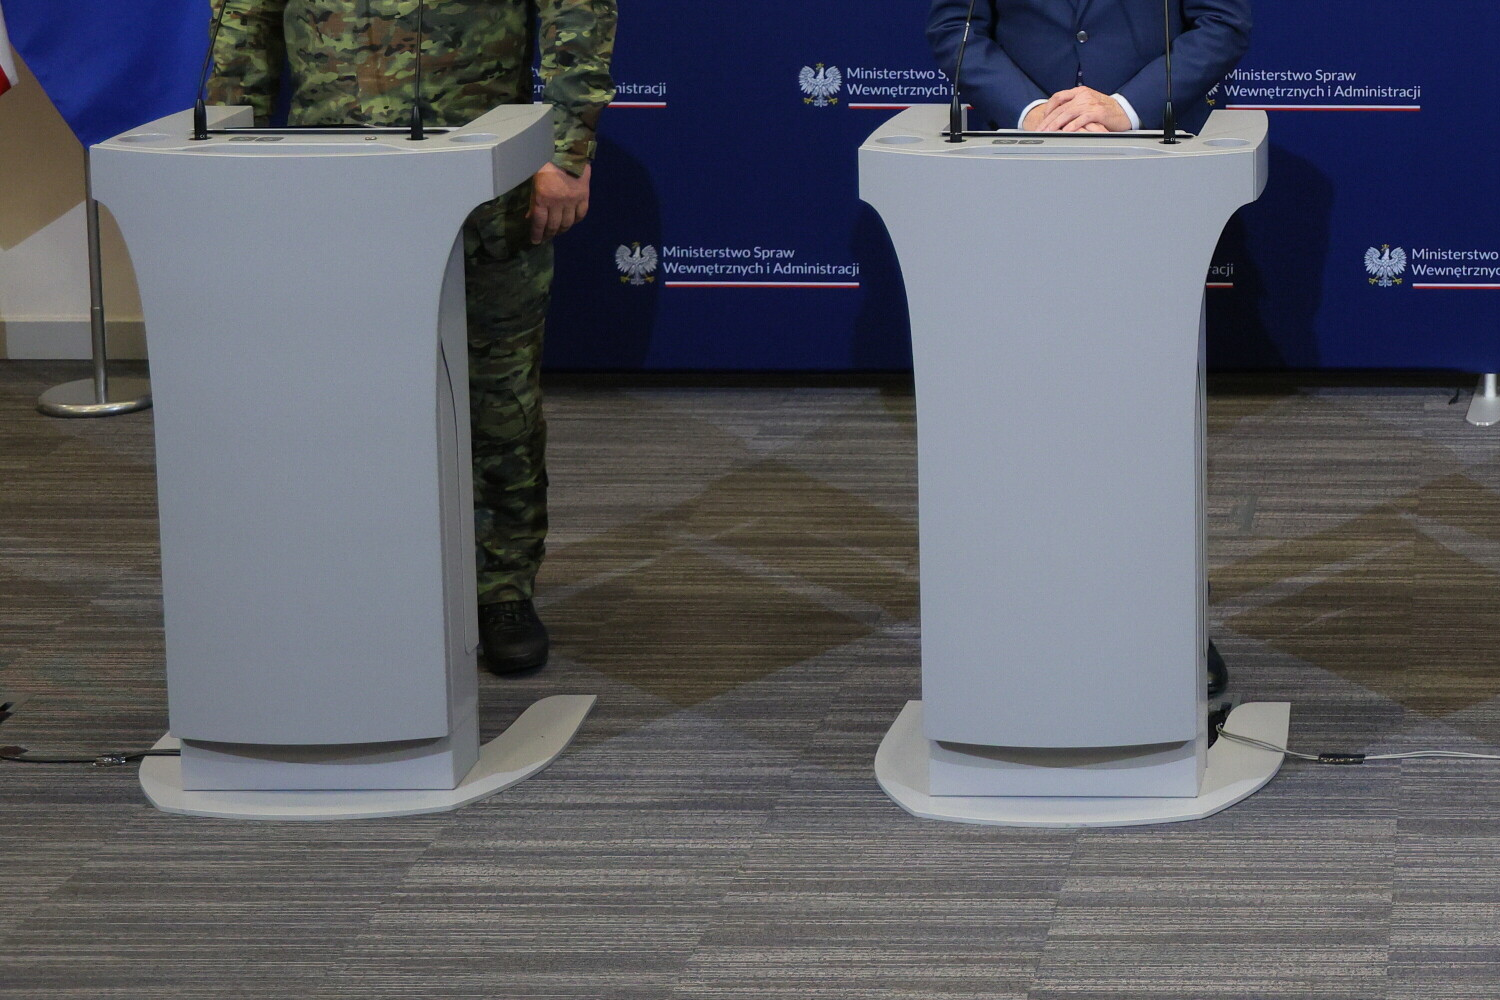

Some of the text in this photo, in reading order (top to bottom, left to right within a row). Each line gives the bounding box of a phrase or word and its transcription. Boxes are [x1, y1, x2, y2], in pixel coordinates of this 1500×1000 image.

[846, 67, 936, 80] Ministerstwo
[1224, 68, 1357, 84] Ministerstwo Spraw
[846, 83, 948, 98] Wewnętrznych
[1224, 84, 1325, 100] Wewnętrznych
[1333, 85, 1421, 100] Administracji
[662, 245, 796, 261] Ministerstwo Spraw
[1411, 248, 1499, 261] Ministerstwo
[662, 261, 764, 277] Wewnętrznych
[772, 262, 860, 278] Administracji
